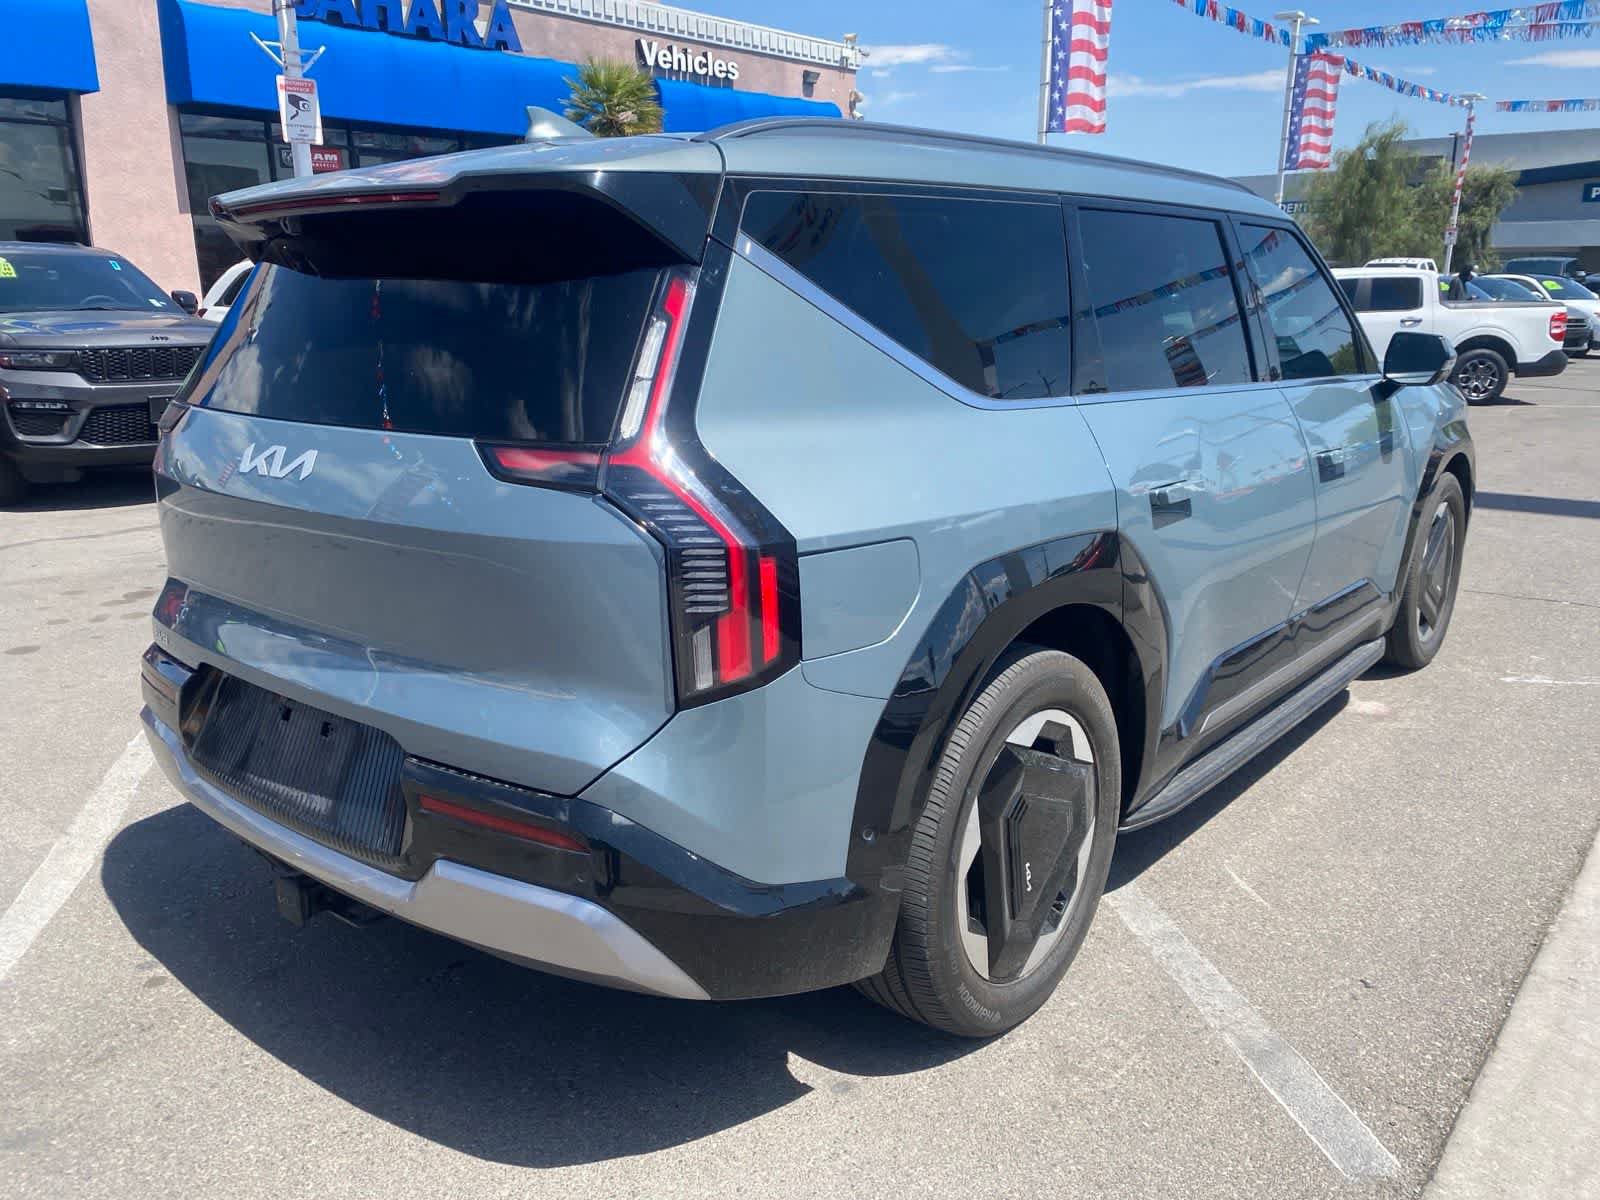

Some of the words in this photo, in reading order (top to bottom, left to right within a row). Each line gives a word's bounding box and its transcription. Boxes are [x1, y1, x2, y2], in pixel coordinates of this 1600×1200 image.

[296, 0, 523, 52] HARA
[640, 38, 739, 80] Vehicles
[239, 442, 319, 481] KIA
